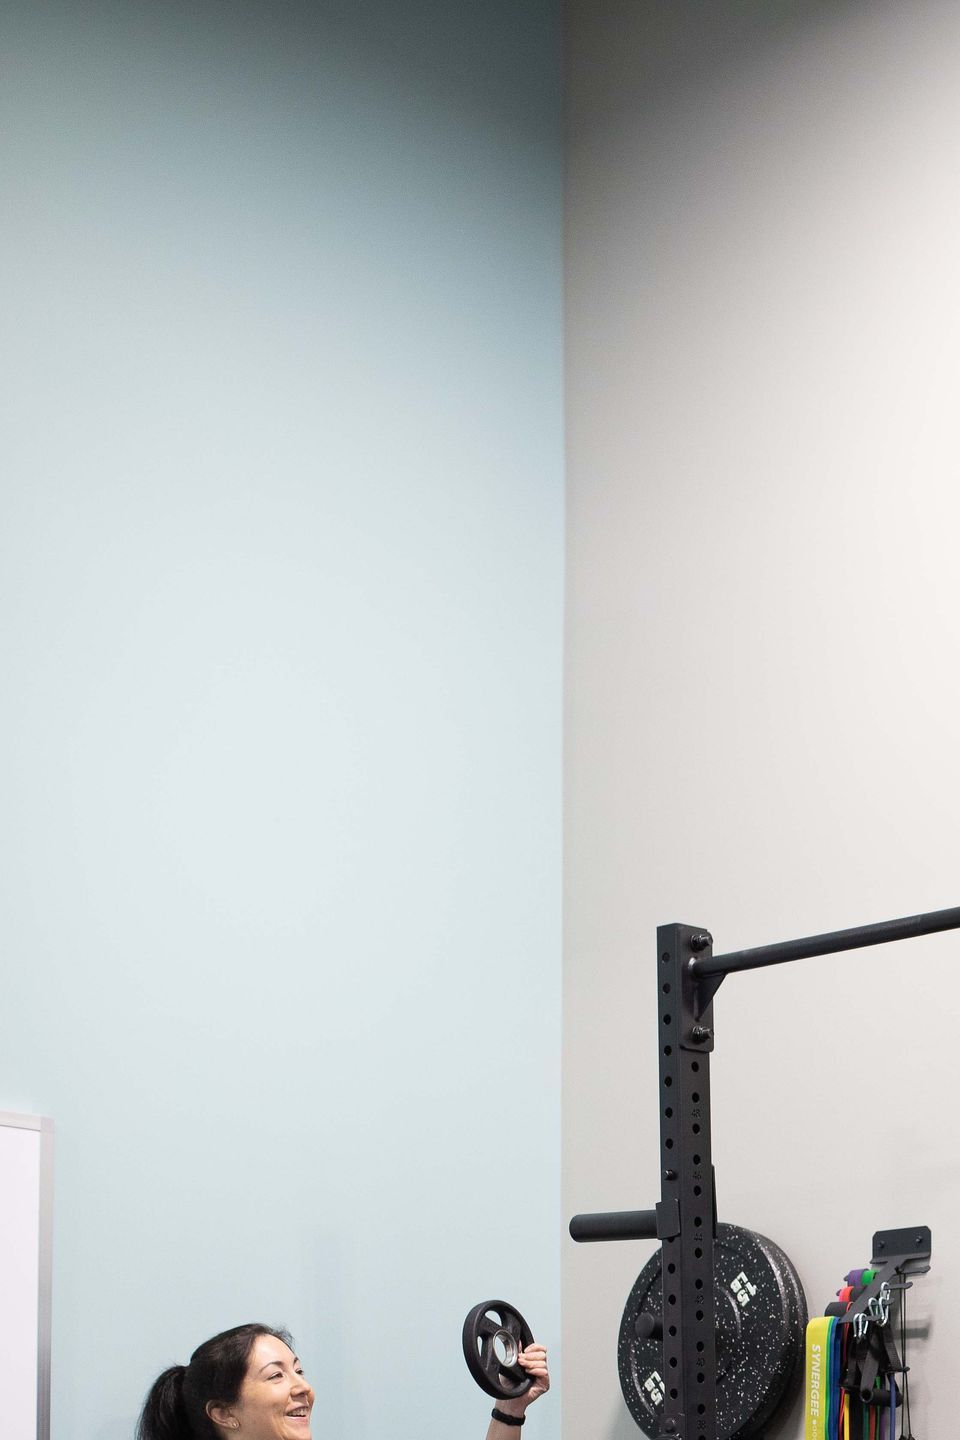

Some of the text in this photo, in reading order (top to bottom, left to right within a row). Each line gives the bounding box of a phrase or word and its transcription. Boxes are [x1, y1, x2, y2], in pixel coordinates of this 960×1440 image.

[730, 1270, 749, 1293] LB
[736, 1281, 757, 1307] 15
[644, 1370, 662, 1392] LB
[810, 1343, 821, 1417] SYNERGEE
